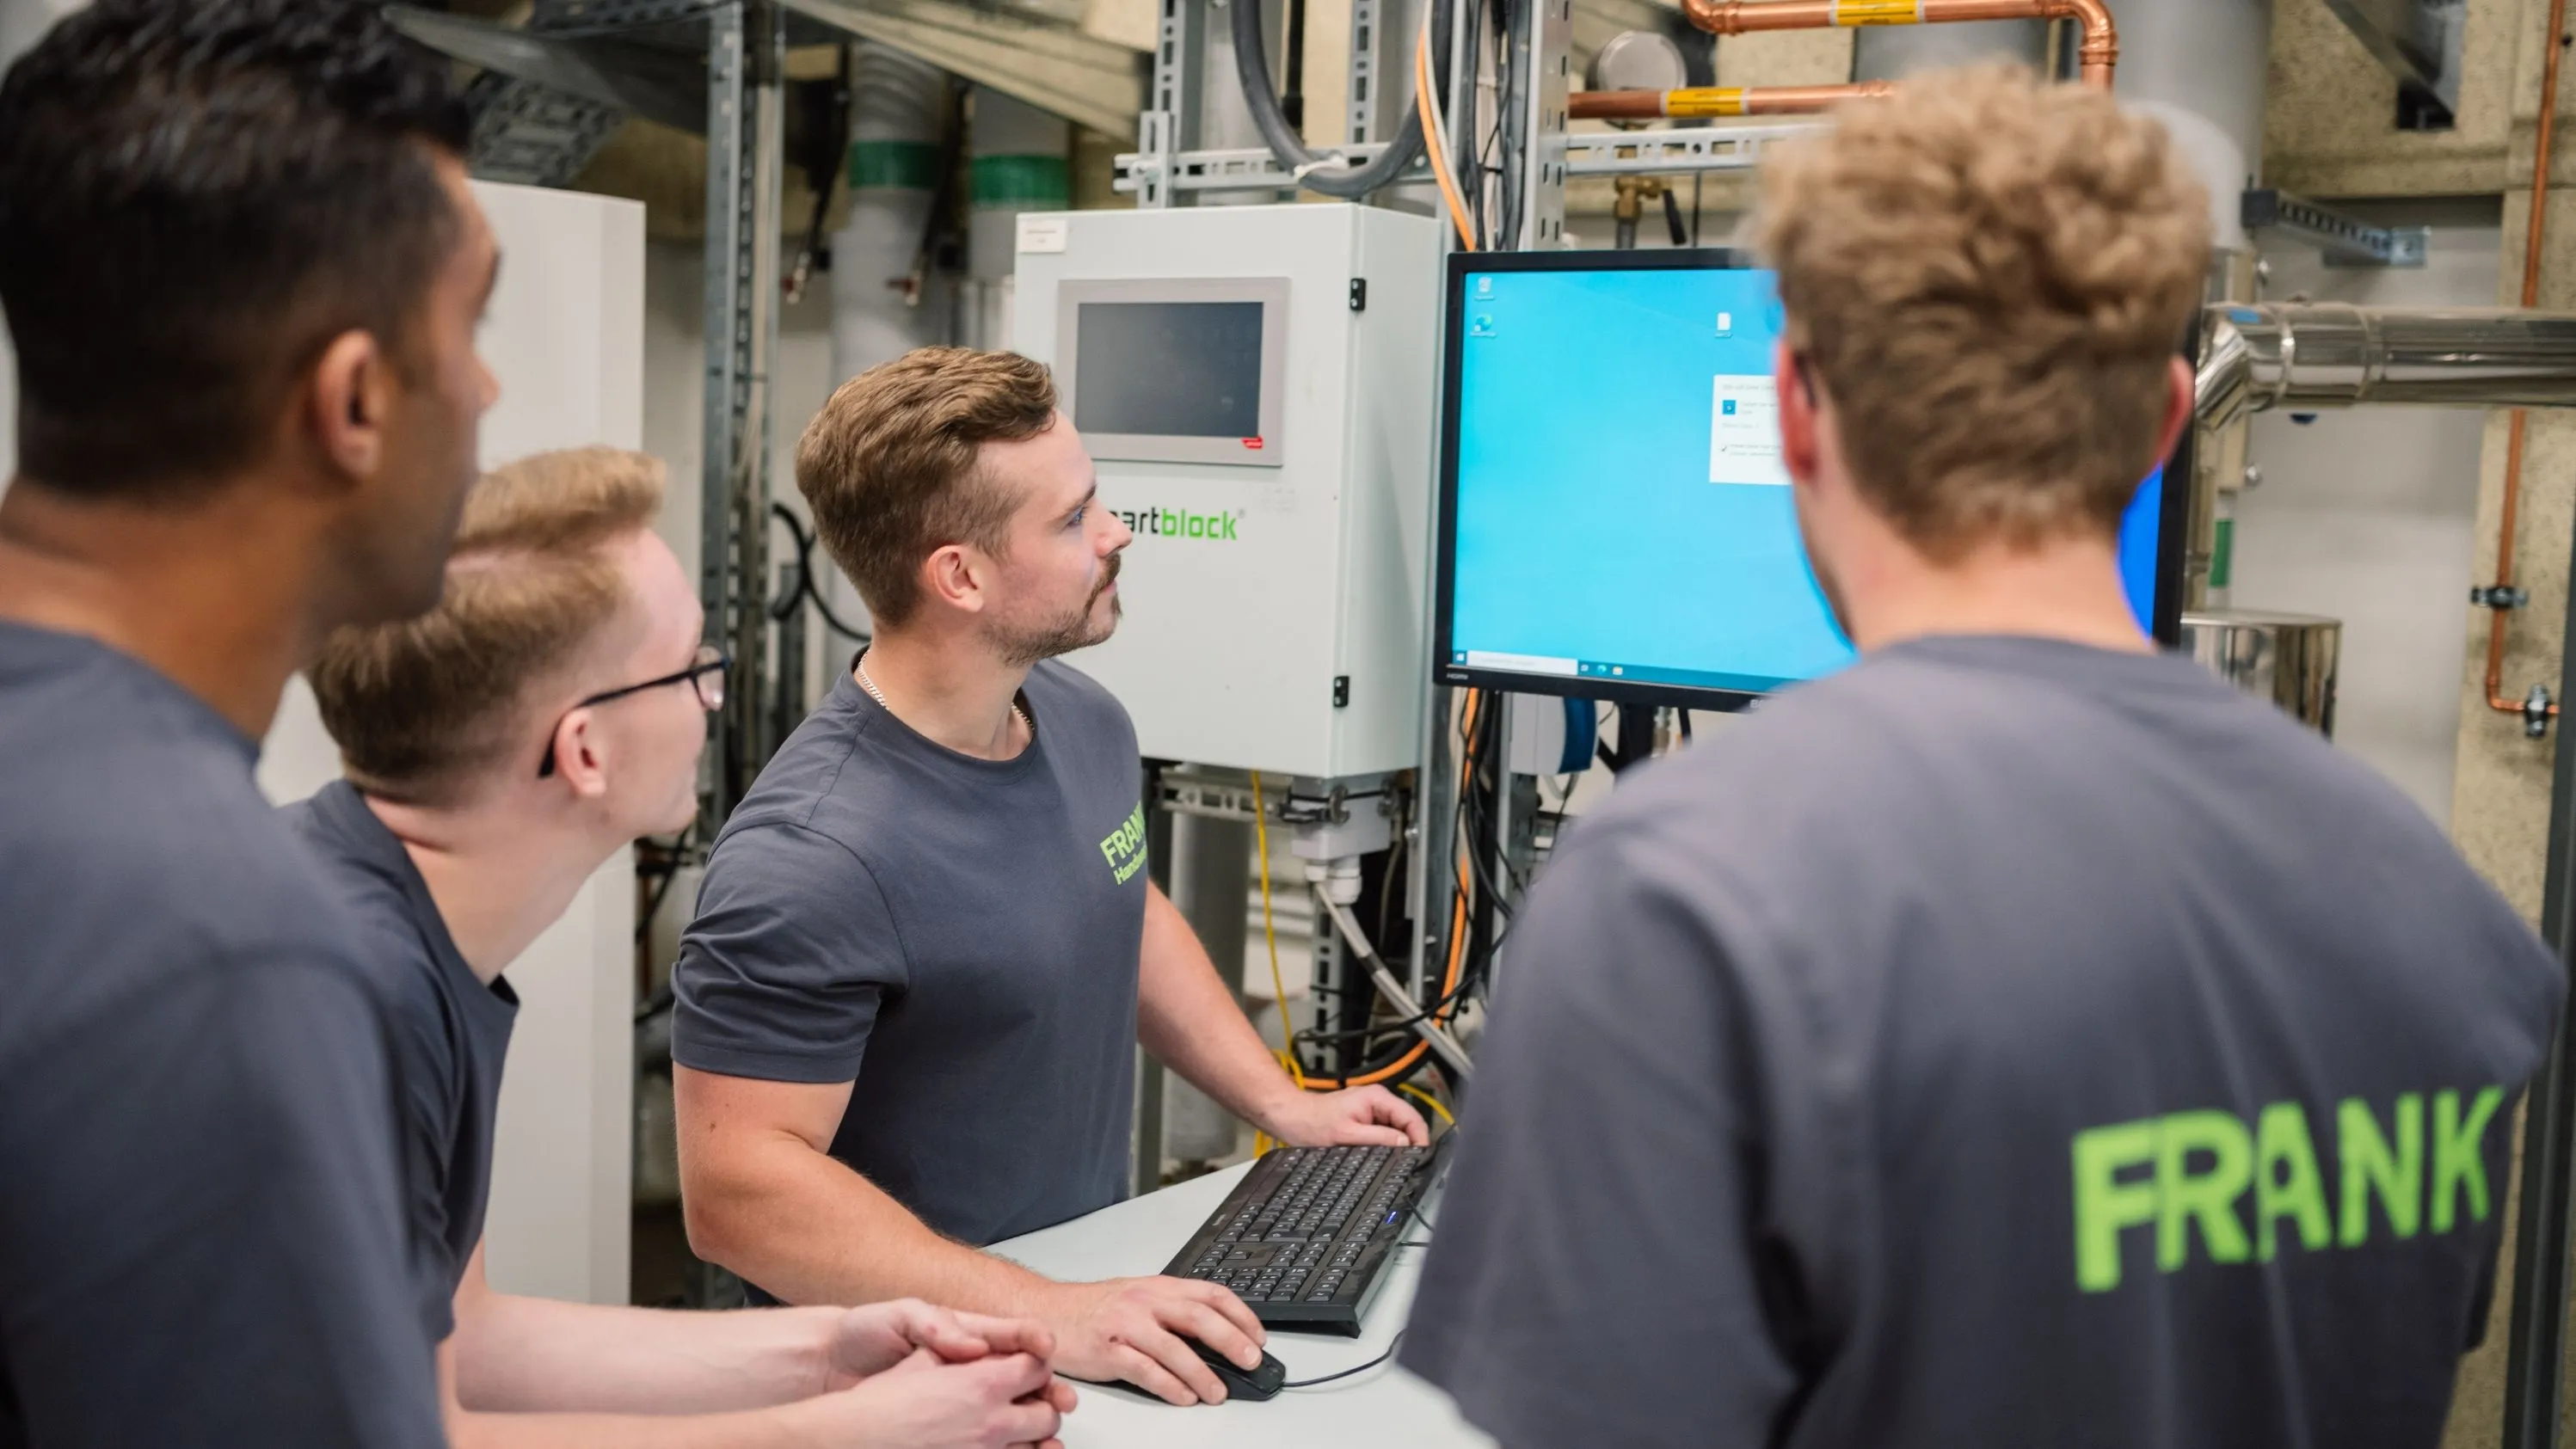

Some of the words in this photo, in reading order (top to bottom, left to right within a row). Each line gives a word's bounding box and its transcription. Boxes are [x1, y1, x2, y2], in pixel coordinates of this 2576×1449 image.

[1110, 507, 1237, 540] artblock
[1099, 800, 1146, 868] FRAN
[2071, 1084, 2505, 1292] FRANK
